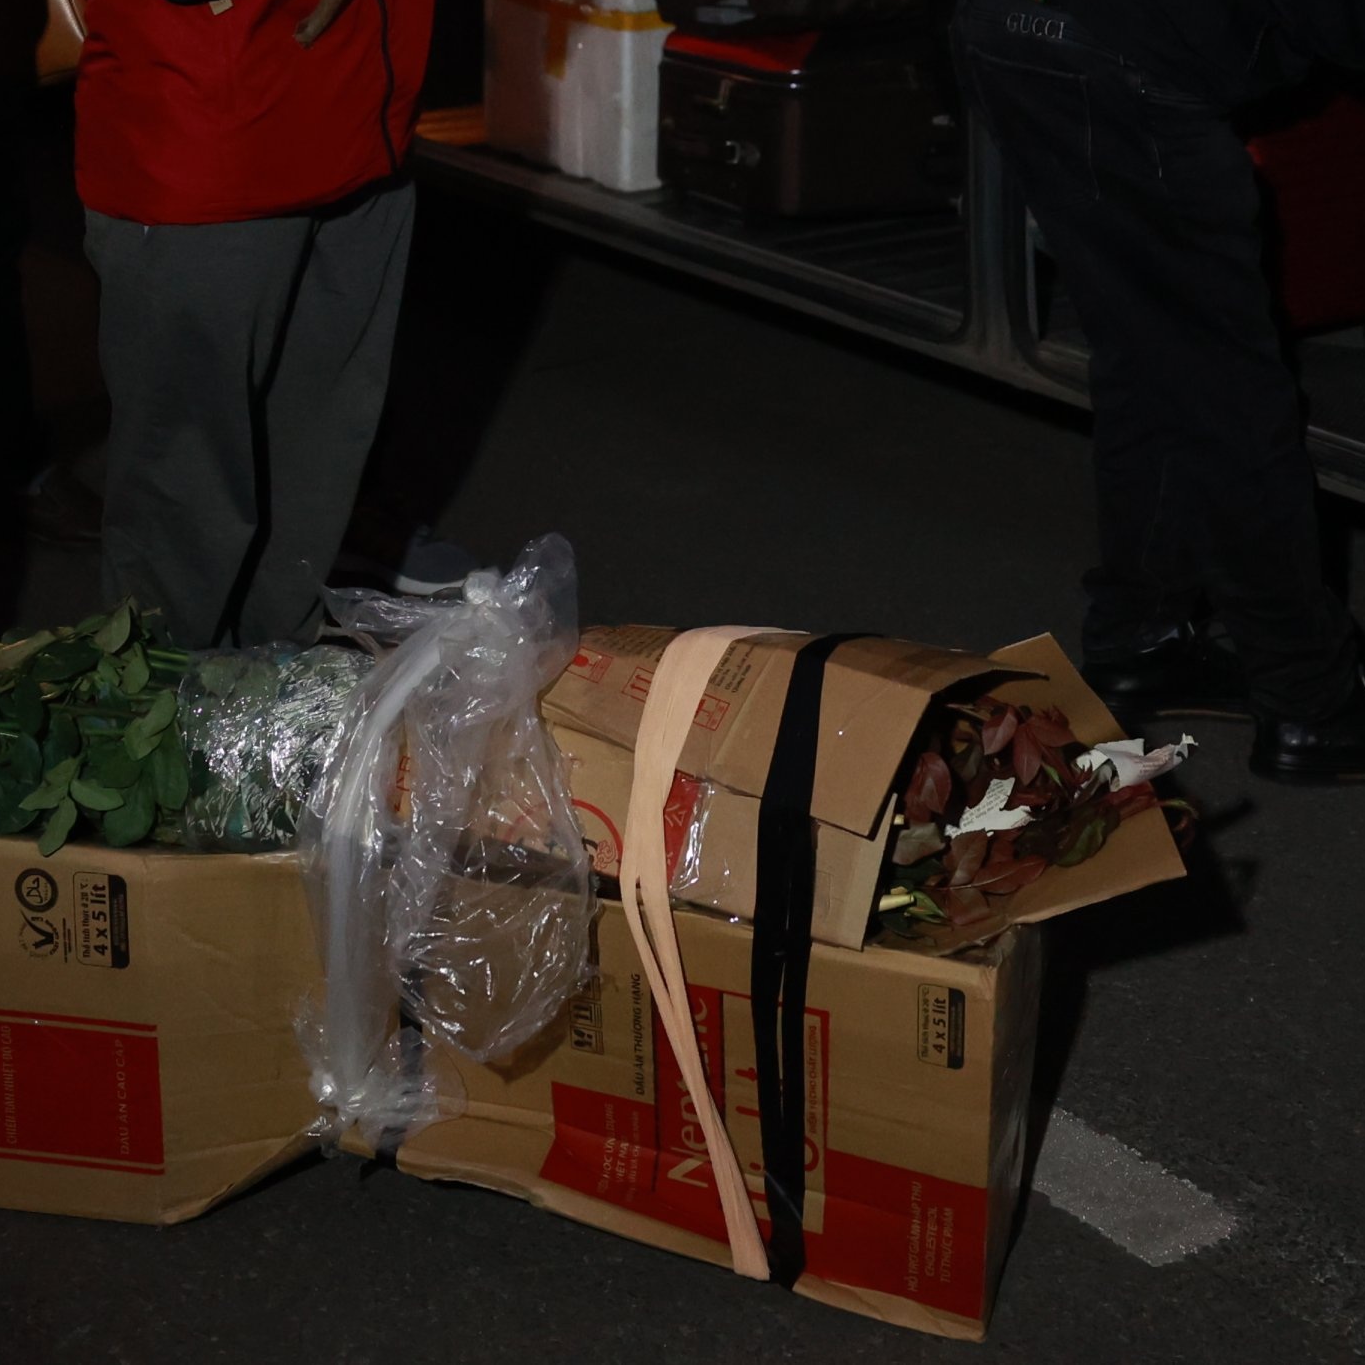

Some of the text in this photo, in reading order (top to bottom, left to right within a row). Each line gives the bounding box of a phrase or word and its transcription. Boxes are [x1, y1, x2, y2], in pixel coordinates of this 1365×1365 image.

[1006, 12, 1065, 40] GUCCI
[90, 884, 108, 956] 4 x 5 lít
[932, 1018, 946, 1028] 5
[935, 1032, 946, 1041] x
[932, 1044, 945, 1054] 4
[116, 1071, 127, 1100] CAO
